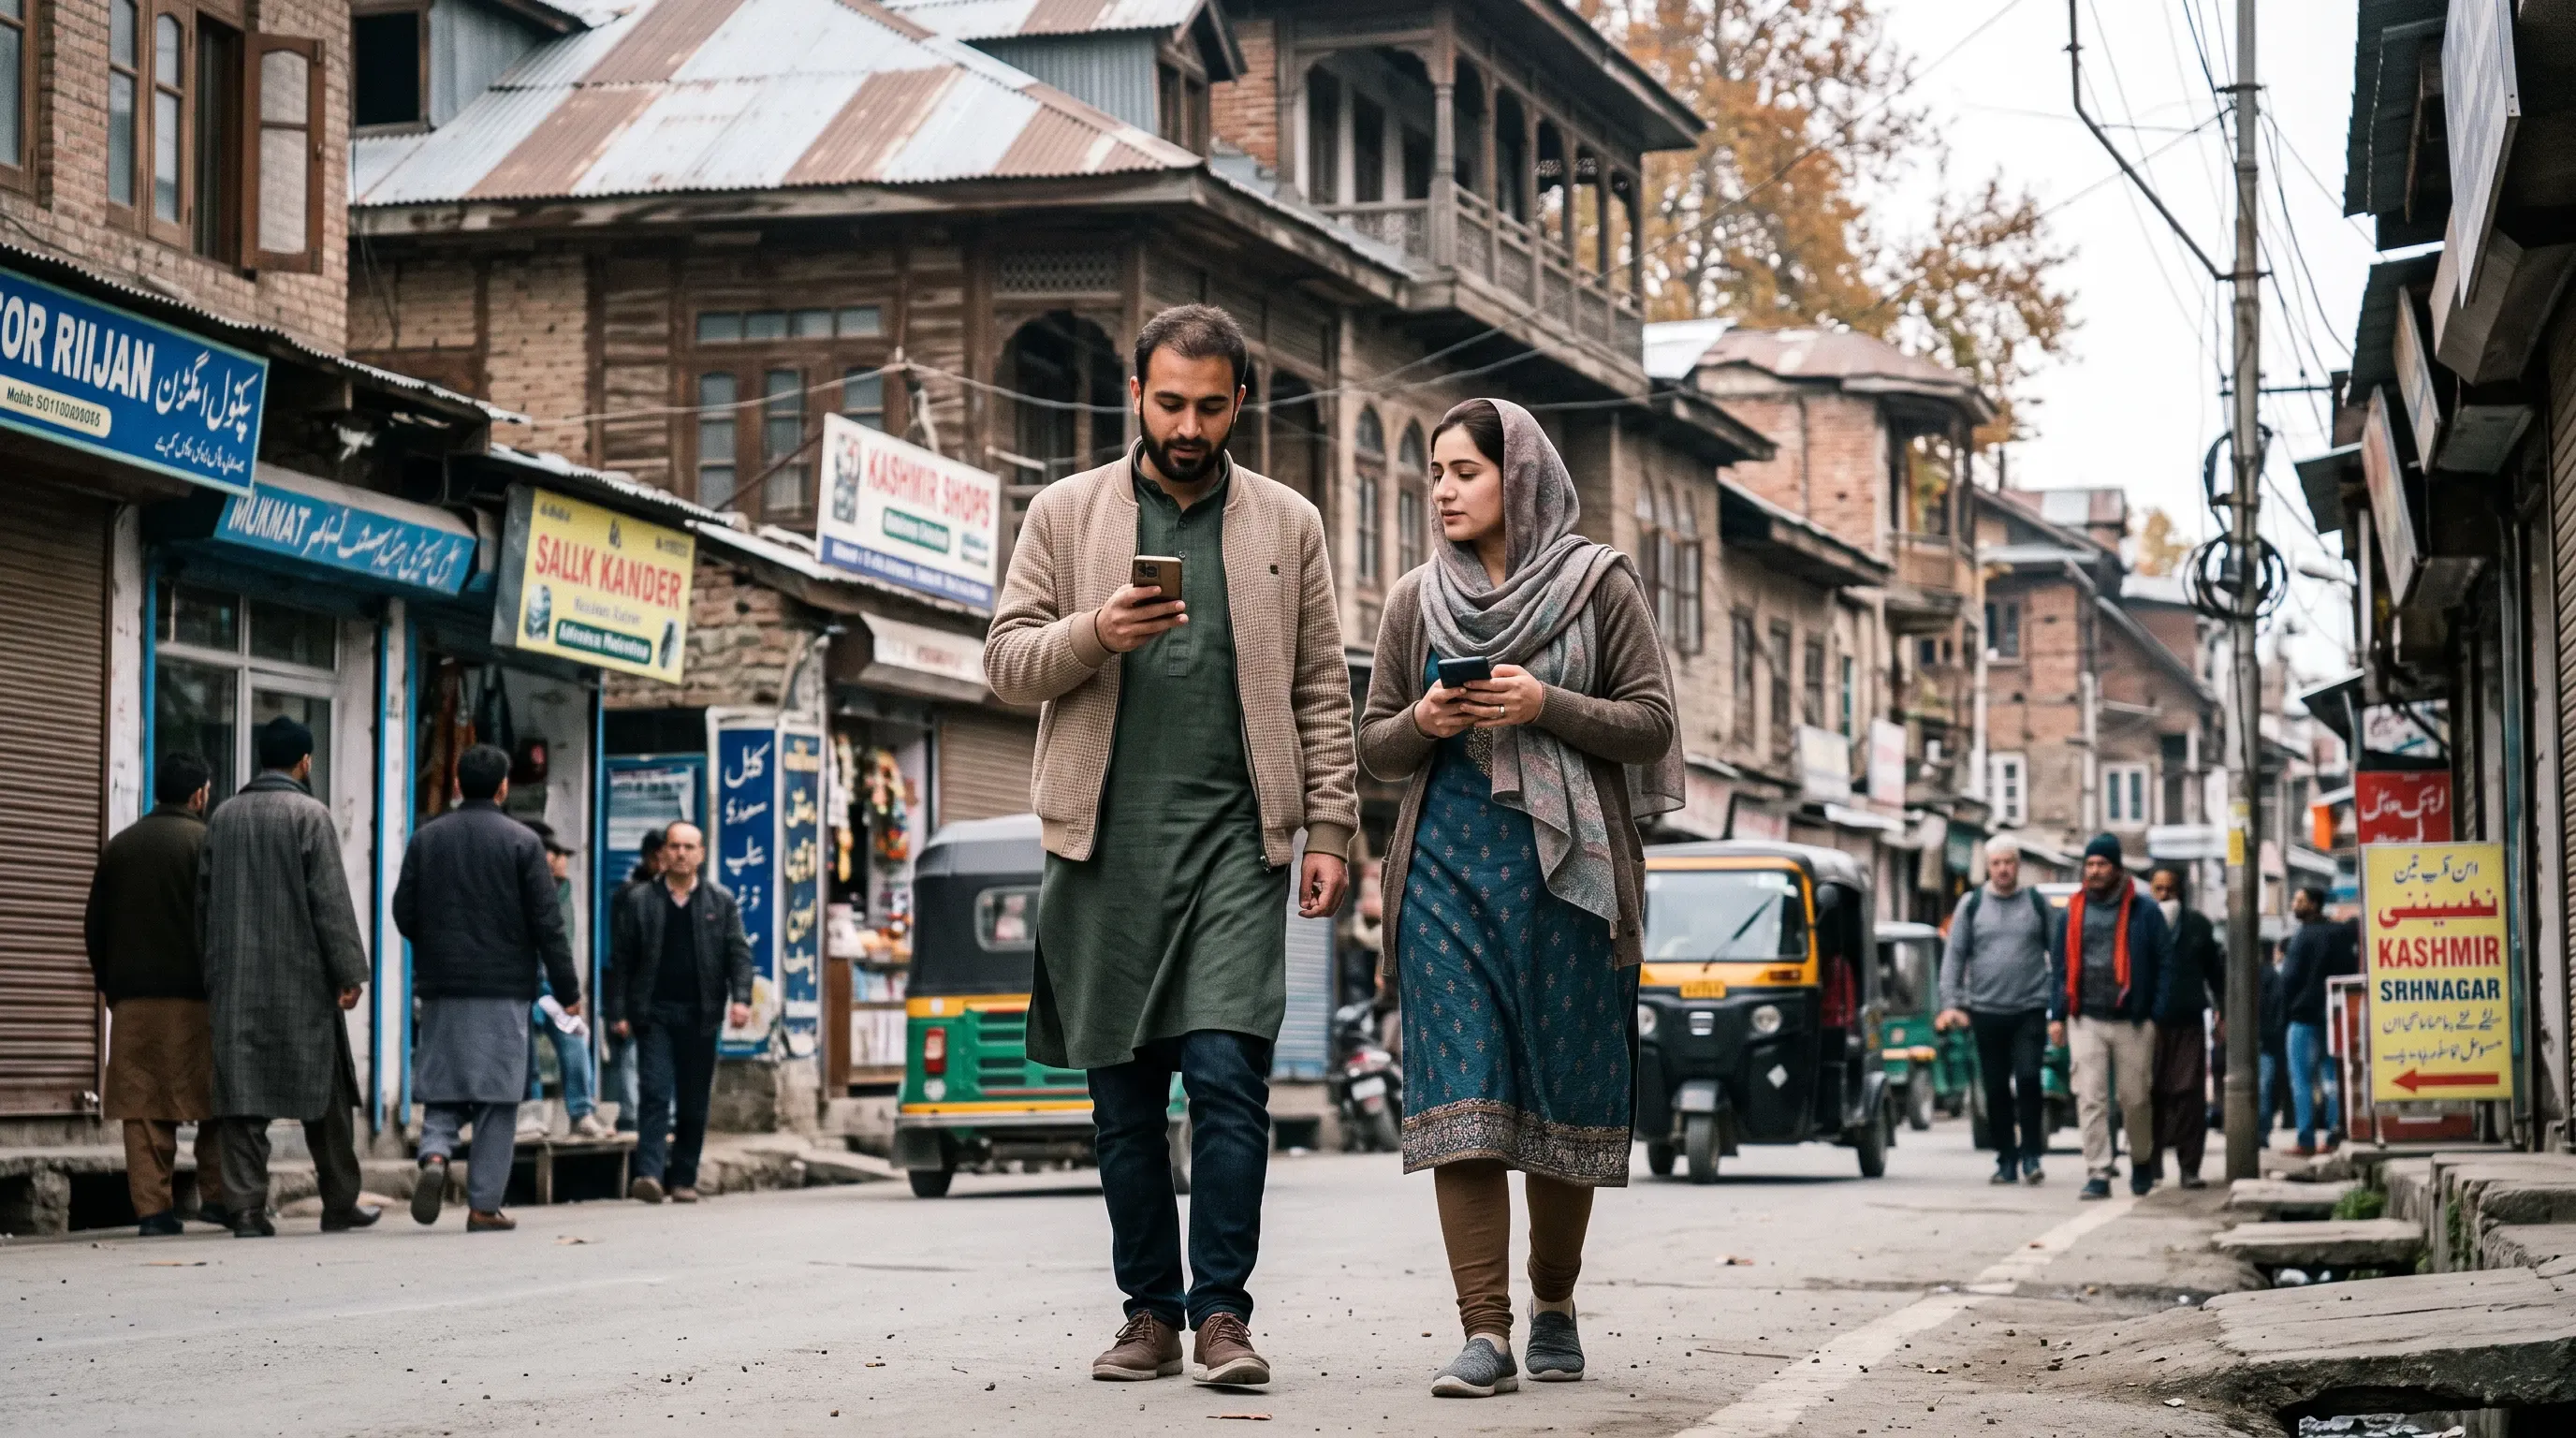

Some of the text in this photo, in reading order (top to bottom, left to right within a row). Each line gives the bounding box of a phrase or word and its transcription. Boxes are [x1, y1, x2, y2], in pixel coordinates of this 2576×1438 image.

[0, 291, 154, 404] OR RIIJAN
[598, 550, 682, 610] KANDER
[2378, 935, 2501, 968] KASHMIR
[2380, 977, 2501, 1003] SRHNAGAR
